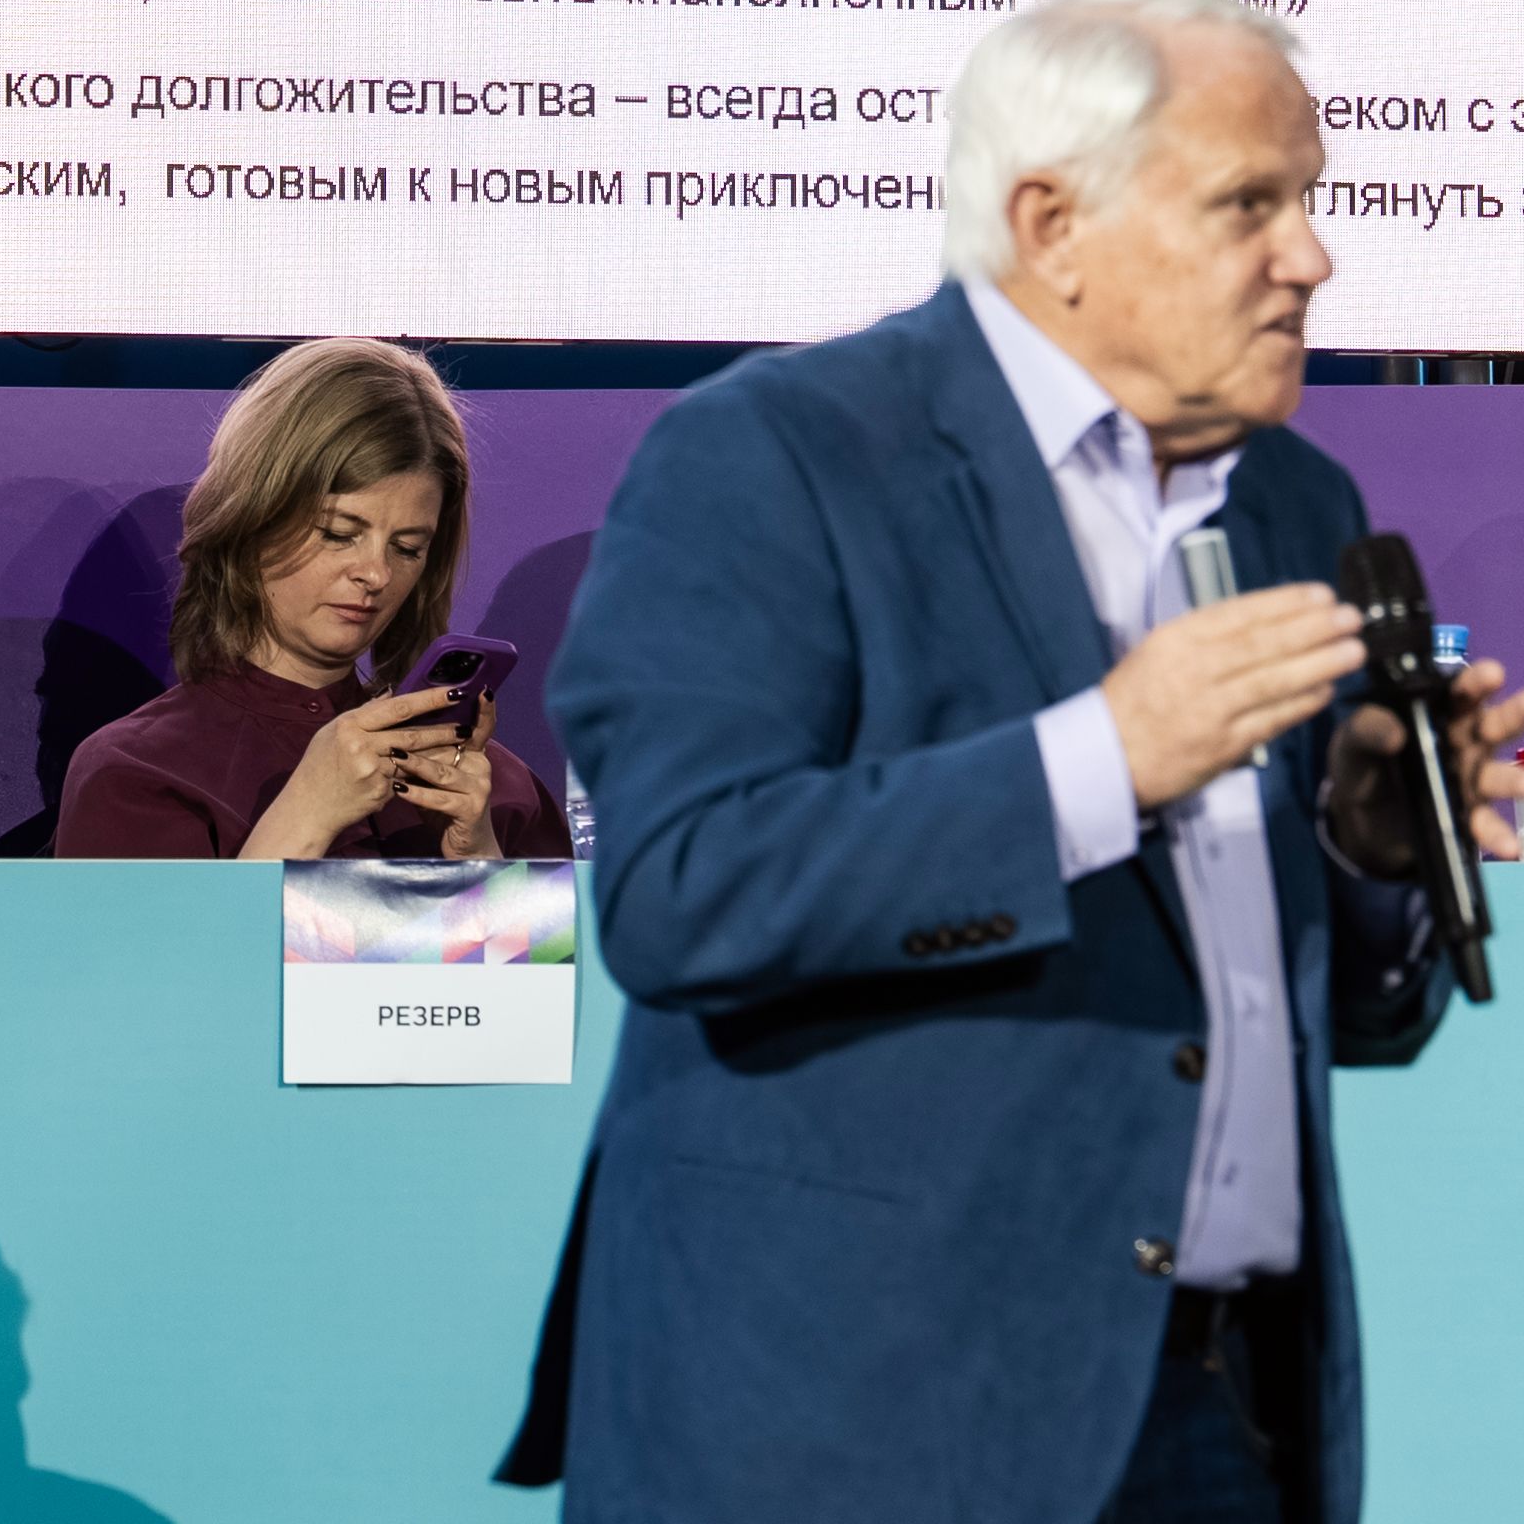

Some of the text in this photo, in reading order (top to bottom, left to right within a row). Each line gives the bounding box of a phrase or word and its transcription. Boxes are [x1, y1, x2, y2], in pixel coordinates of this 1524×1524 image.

[128, 73, 598, 119] долгожительства
[666, 82, 840, 131] всегда
[1466, 96, 1495, 134] с
[165, 162, 389, 203] готовым
[407, 166, 432, 204] к
[449, 166, 625, 207] новым
[644, 169, 946, 220] приключен
[1309, 179, 1505, 232] глянуть
[378, 1005, 482, 1027] РЕЗЕРВ
